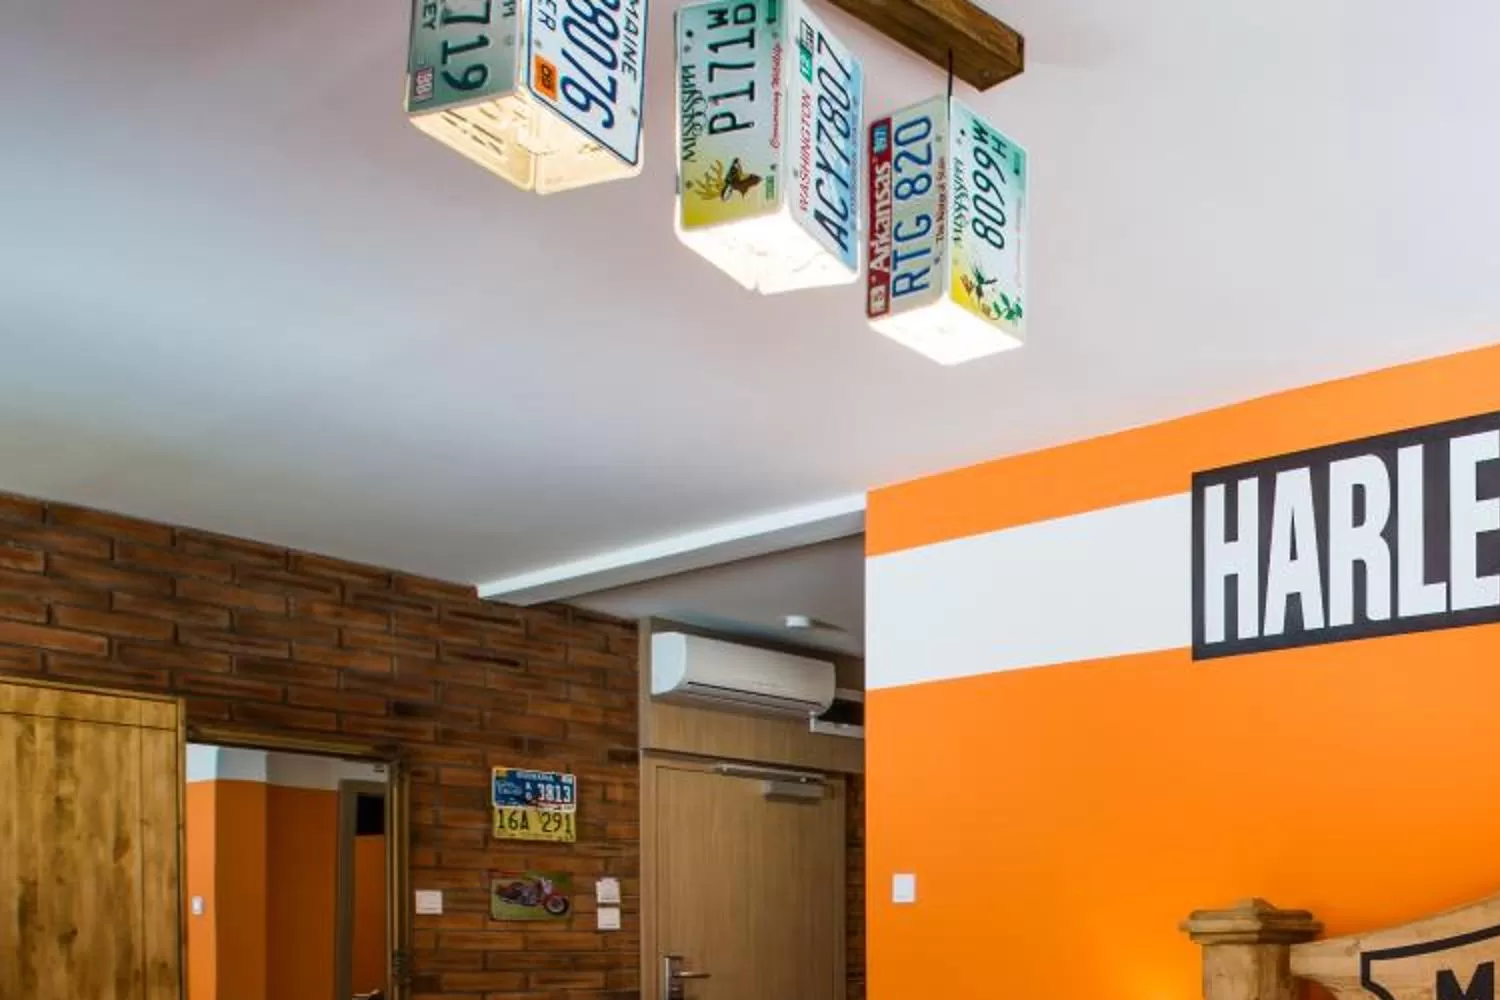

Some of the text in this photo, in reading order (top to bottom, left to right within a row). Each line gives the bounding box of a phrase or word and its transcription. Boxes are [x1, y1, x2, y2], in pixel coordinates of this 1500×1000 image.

[559, 0, 621, 129] 8076
[621, 0, 643, 81] MAINE
[799, 90, 812, 211] WASHINGTON
[813, 32, 853, 252] ACY7807
[870, 159, 893, 273] Arkansas
[892, 115, 933, 298] RTG 820
[498, 808, 530, 832] 16A
